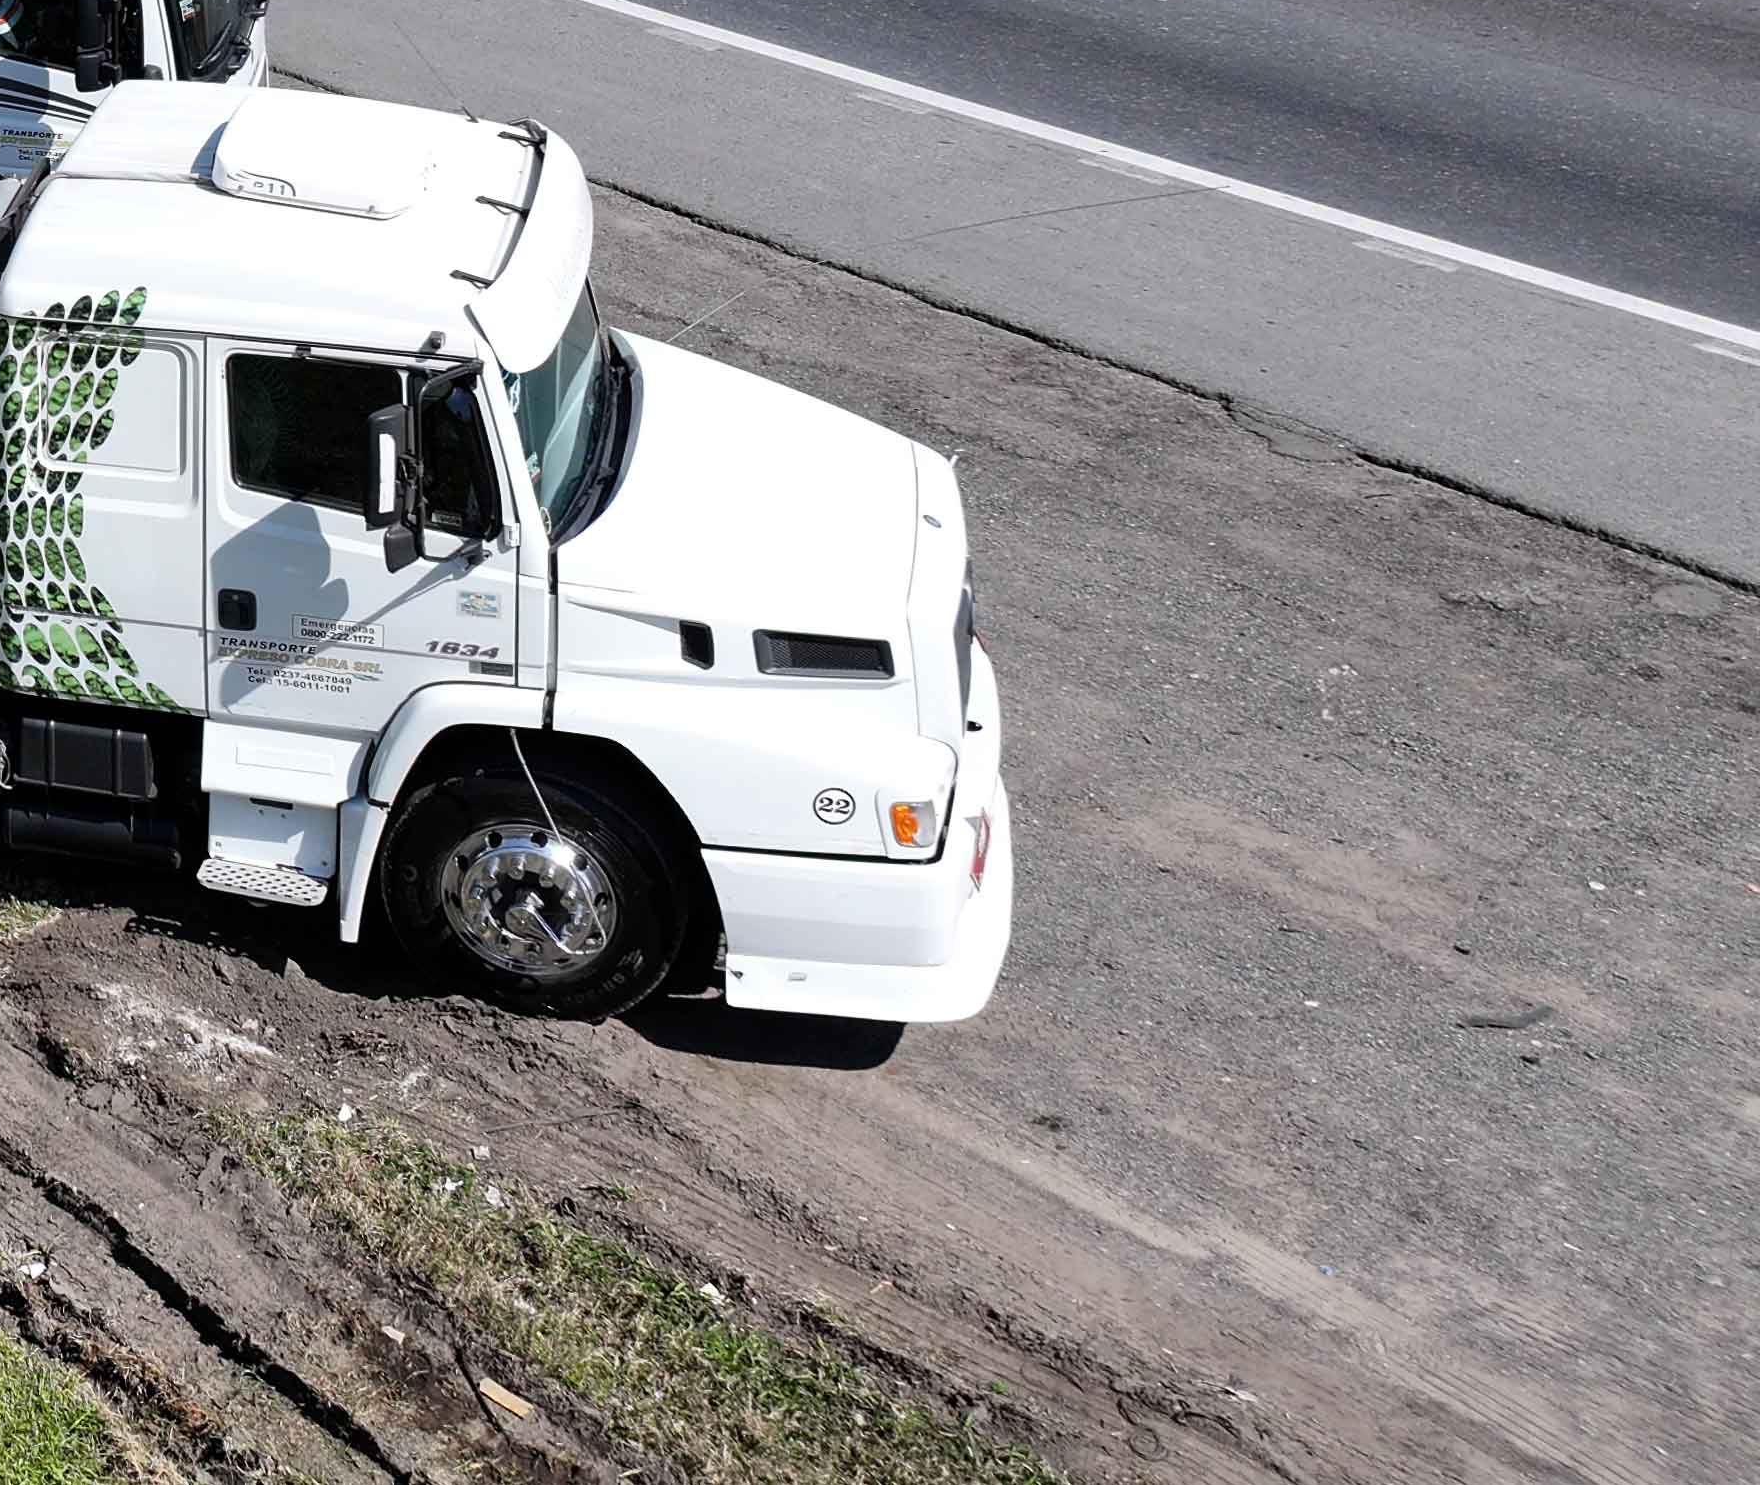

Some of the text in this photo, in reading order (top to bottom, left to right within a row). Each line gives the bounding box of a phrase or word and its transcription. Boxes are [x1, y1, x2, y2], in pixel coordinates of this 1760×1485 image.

[300, 628, 375, 645] 0800-222-1172
[220, 637, 318, 655] TRANSPORTE
[425, 640, 500, 659] 1634
[295, 655, 350, 671] COBRA
[353, 661, 383, 675] SRL
[818, 797, 851, 815] 22
